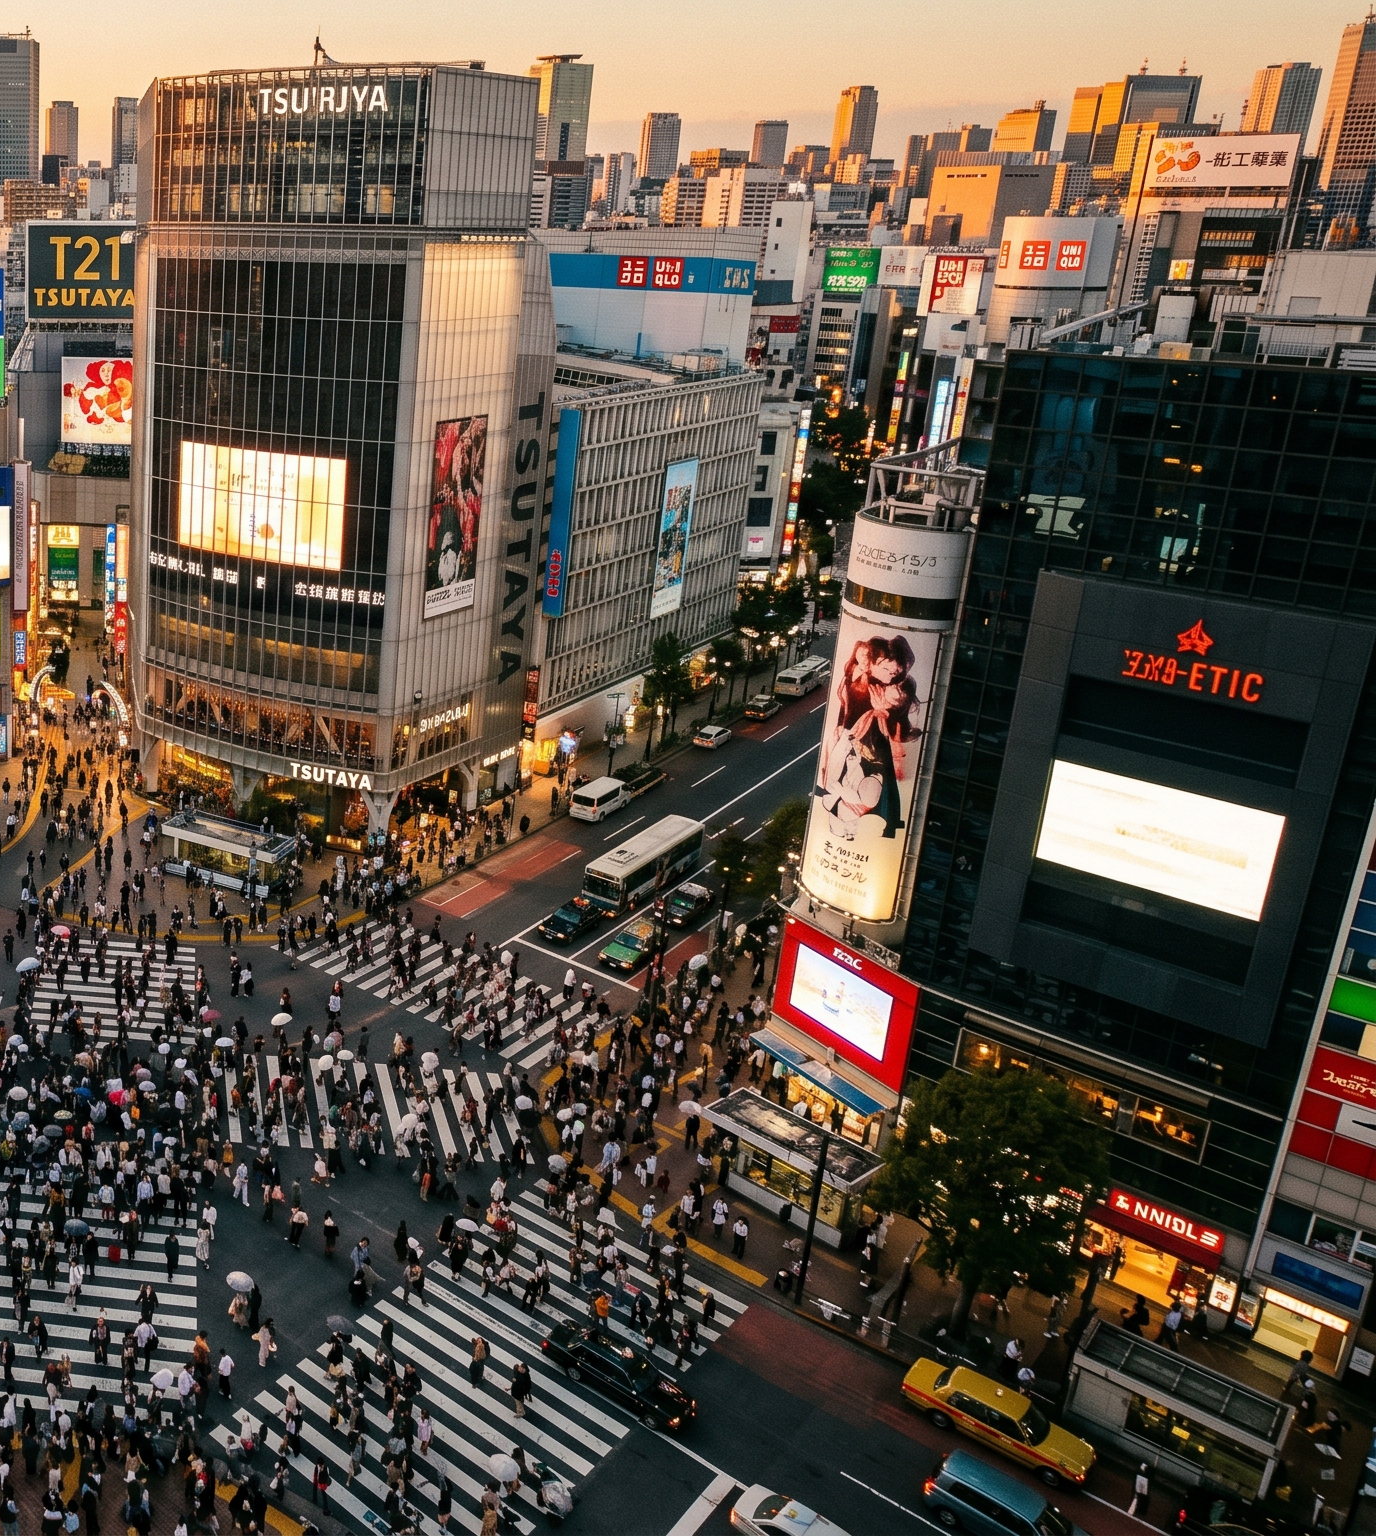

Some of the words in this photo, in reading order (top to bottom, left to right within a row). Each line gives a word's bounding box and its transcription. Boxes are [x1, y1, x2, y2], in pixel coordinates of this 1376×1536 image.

[50, 236, 120, 281] T21
[498, 391, 545, 685] TSUTAYA
[290, 762, 372, 791] TSUTAYA
